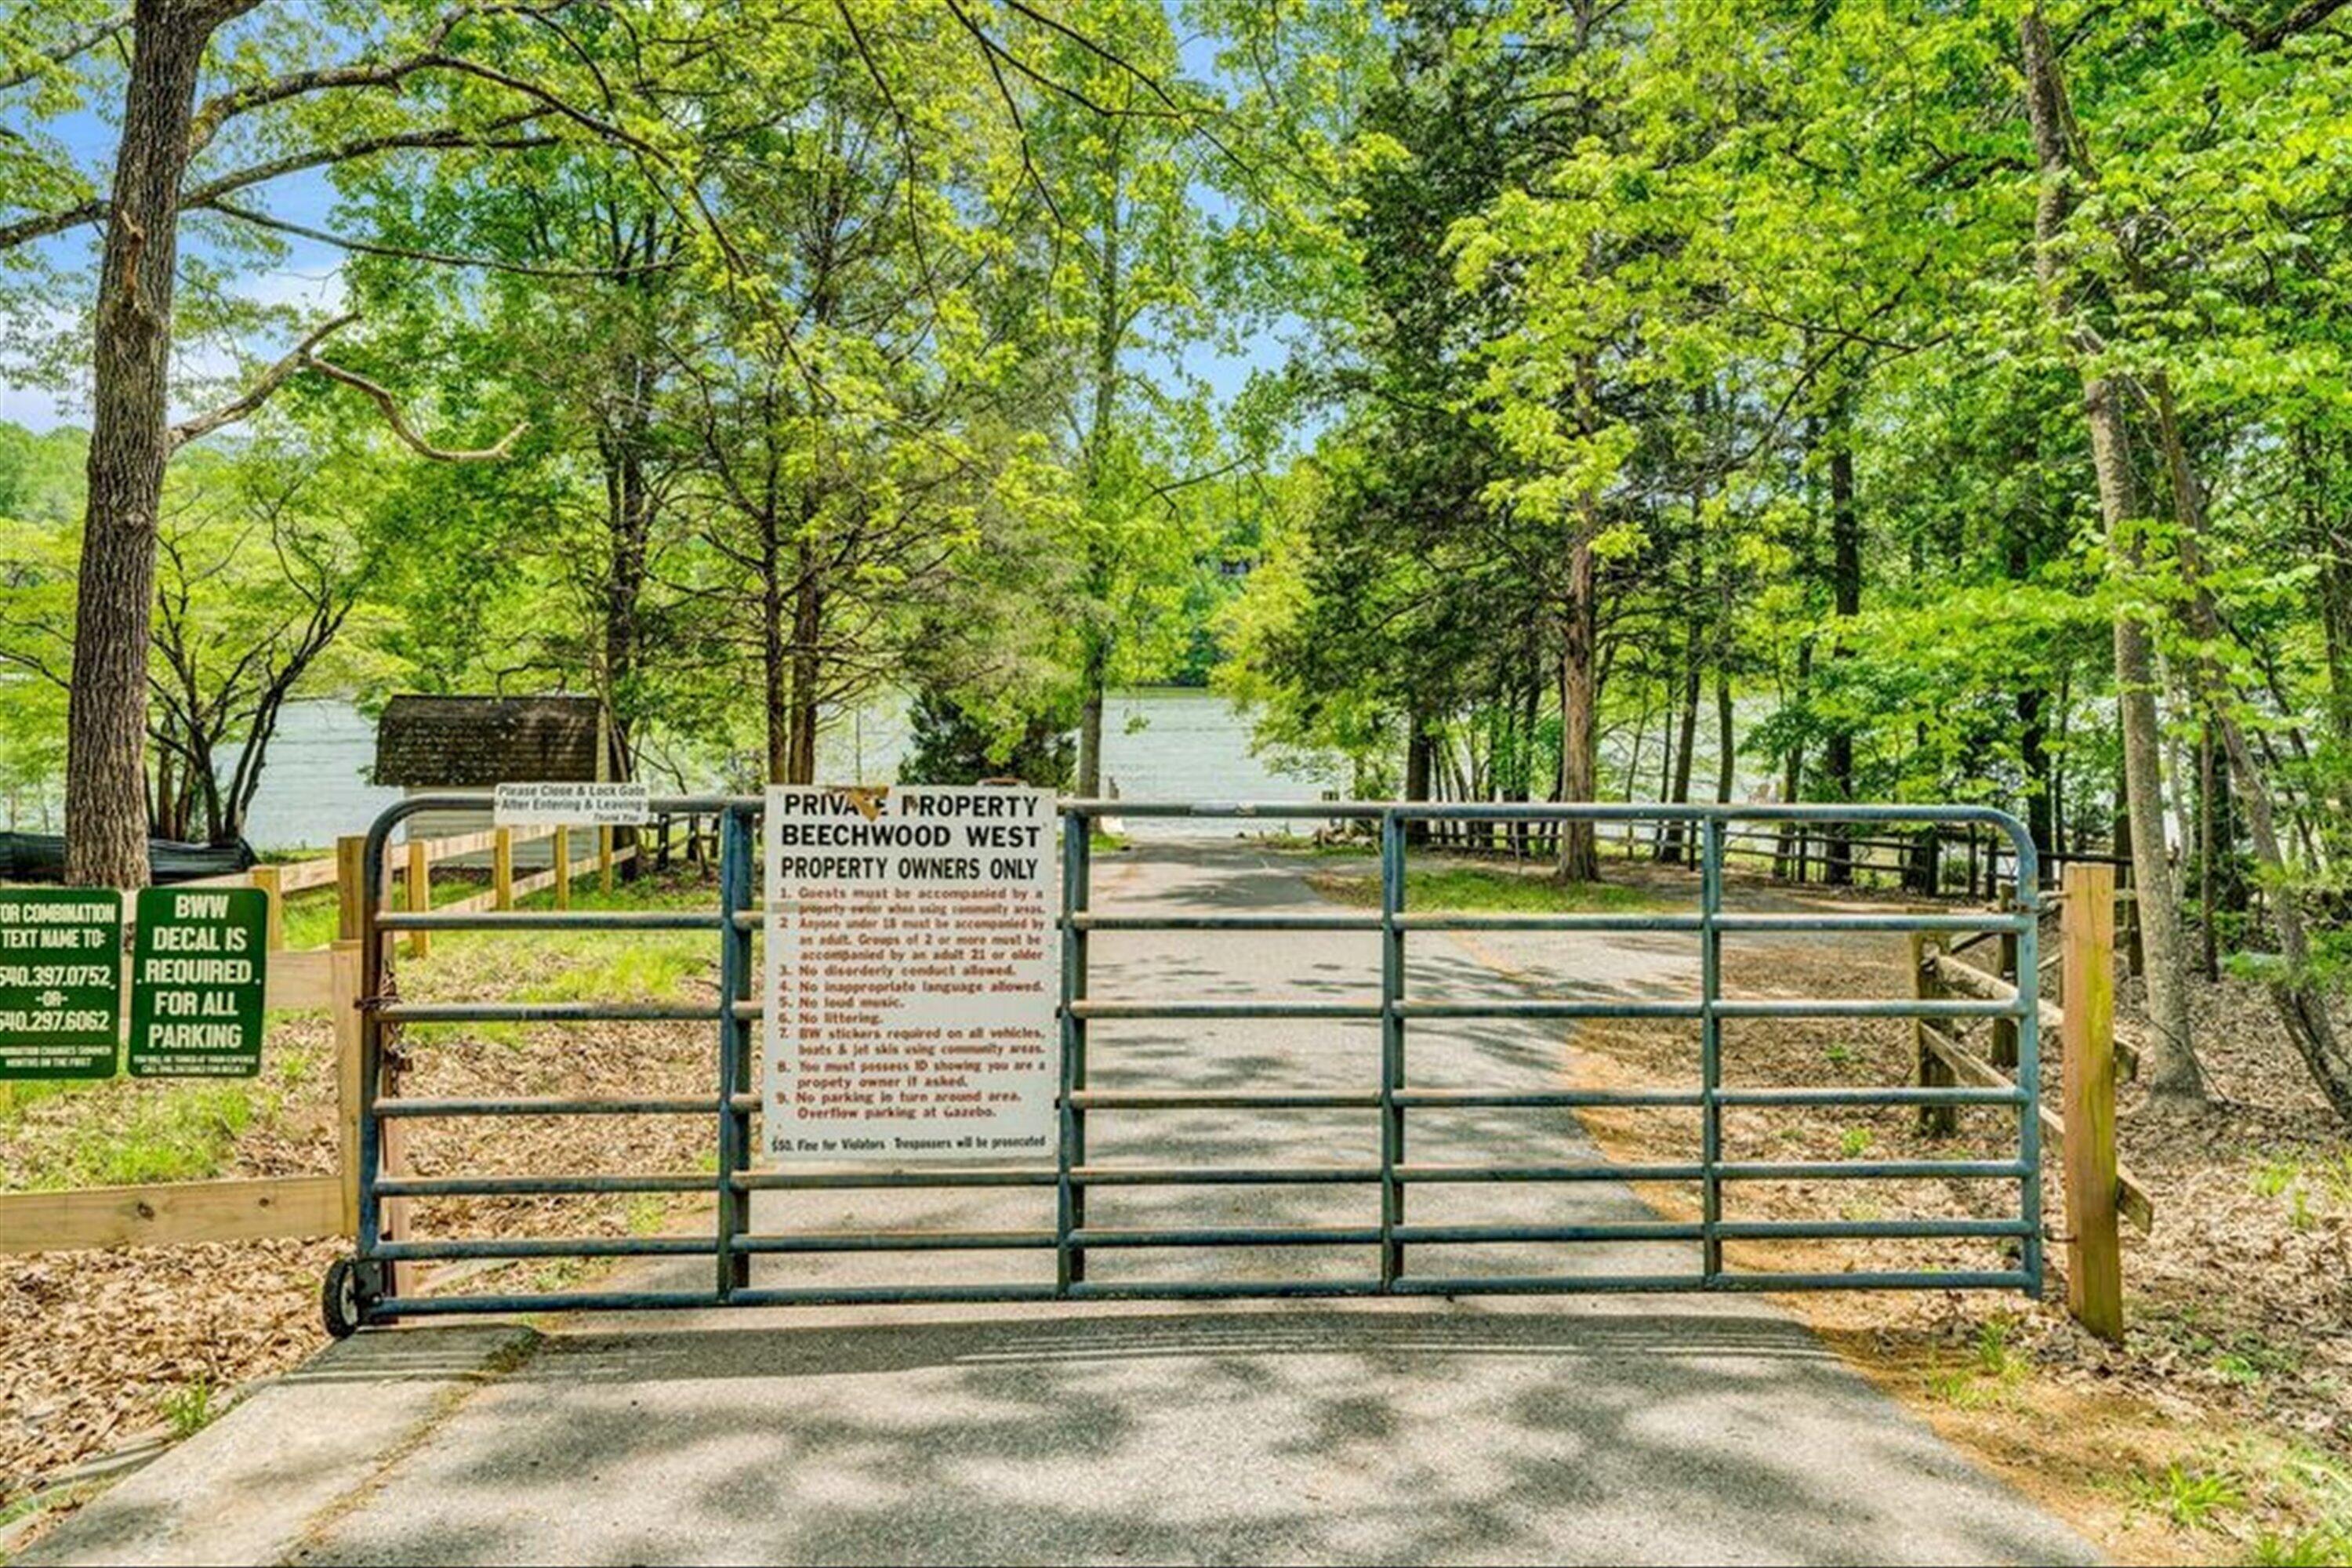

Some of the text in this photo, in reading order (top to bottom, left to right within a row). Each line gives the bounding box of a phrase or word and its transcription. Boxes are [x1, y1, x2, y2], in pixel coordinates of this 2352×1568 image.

[499, 786, 645, 797] Please Close & Lock Gate
[502, 799, 641, 811] After Entering & Leaving
[785, 794, 1039, 817] PRIVAE PROPERTY
[782, 825, 1040, 848] BEECHWOOD WEST
[782, 857, 1038, 880] PROPERTY OWNERS ONLY
[780, 887, 1043, 900] 1. Guests must be accompanied by a
[0, 903, 116, 924] OR COMBINATION
[175, 895, 230, 919] BWW
[952, 904, 1007, 916] community
[799, 918, 840, 931] Anyone
[847, 918, 878, 928] under
[902, 918, 930, 928] must
[936, 918, 949, 928] be
[955, 918, 1026, 930] accompanied
[1032, 919, 1044, 930] by
[1, 928, 38, 949] TEXT
[40, 929, 79, 949] NAME
[153, 927, 248, 952] DECAL IS
[800, 935, 813, 945] an
[858, 933, 900, 946] Groups
[906, 933, 919, 945] of
[925, 934, 931, 945] 2
[938, 936, 950, 945] or
[956, 936, 985, 945] more
[991, 935, 1022, 945] must
[1027, 934, 1040, 945] be
[800, 949, 1043, 962] accompanied by an adult 21 or older
[145, 959, 252, 984] REQUIRED
[800, 964, 818, 976] No
[825, 964, 893, 978] disorderly
[902, 965, 955, 976] conduct
[963, 964, 1016, 976] allowed.
[779, 980, 1044, 994] 4. No inappropriate language allowed.
[154, 992, 239, 1016] FOR ALL
[800, 996, 818, 1008] No
[825, 996, 855, 1008] loud
[860, 996, 905, 1008] music.
[799, 1012, 818, 1024] No
[824, 1012, 884, 1025] littering.
[148, 1024, 243, 1048] PARKING
[800, 1028, 821, 1040] BW
[829, 1027, 881, 1039] stickers
[887, 1028, 940, 1040] required
[947, 1029, 963, 1039] on
[969, 1027, 983, 1039] all
[798, 1044, 832, 1055] boats
[838, 1044, 847, 1055] &
[854, 1044, 869, 1057] jet
[875, 1044, 898, 1055] skis
[905, 1044, 935, 1056] using
[942, 1044, 1003, 1056] community
[799, 1060, 820, 1072] You
[825, 1061, 855, 1072] must
[861, 1062, 909, 1073] possess
[915, 1060, 928, 1071] ID
[935, 1060, 981, 1073] showing
[989, 1062, 1009, 1073] you
[1014, 1062, 1033, 1070] are
[1038, 1062, 1045, 1070] a
[797, 1076, 967, 1089] propety owner if asked.
[796, 1092, 815, 1102] No
[822, 1091, 873, 1105] parking
[899, 1091, 928, 1102] turn
[935, 1091, 982, 1102] around
[989, 1091, 1022, 1102] area.
[797, 1106, 996, 1120] Overflow parking at Gazebo.
[797, 1139, 818, 1151] Fine
[823, 1139, 837, 1150] for
[841, 1138, 885, 1150] Violators
[895, 1137, 952, 1150] Trespassers
[956, 1137, 972, 1148] will
[976, 1137, 988, 1148] be
[992, 1136, 1046, 1149] prosecuted
